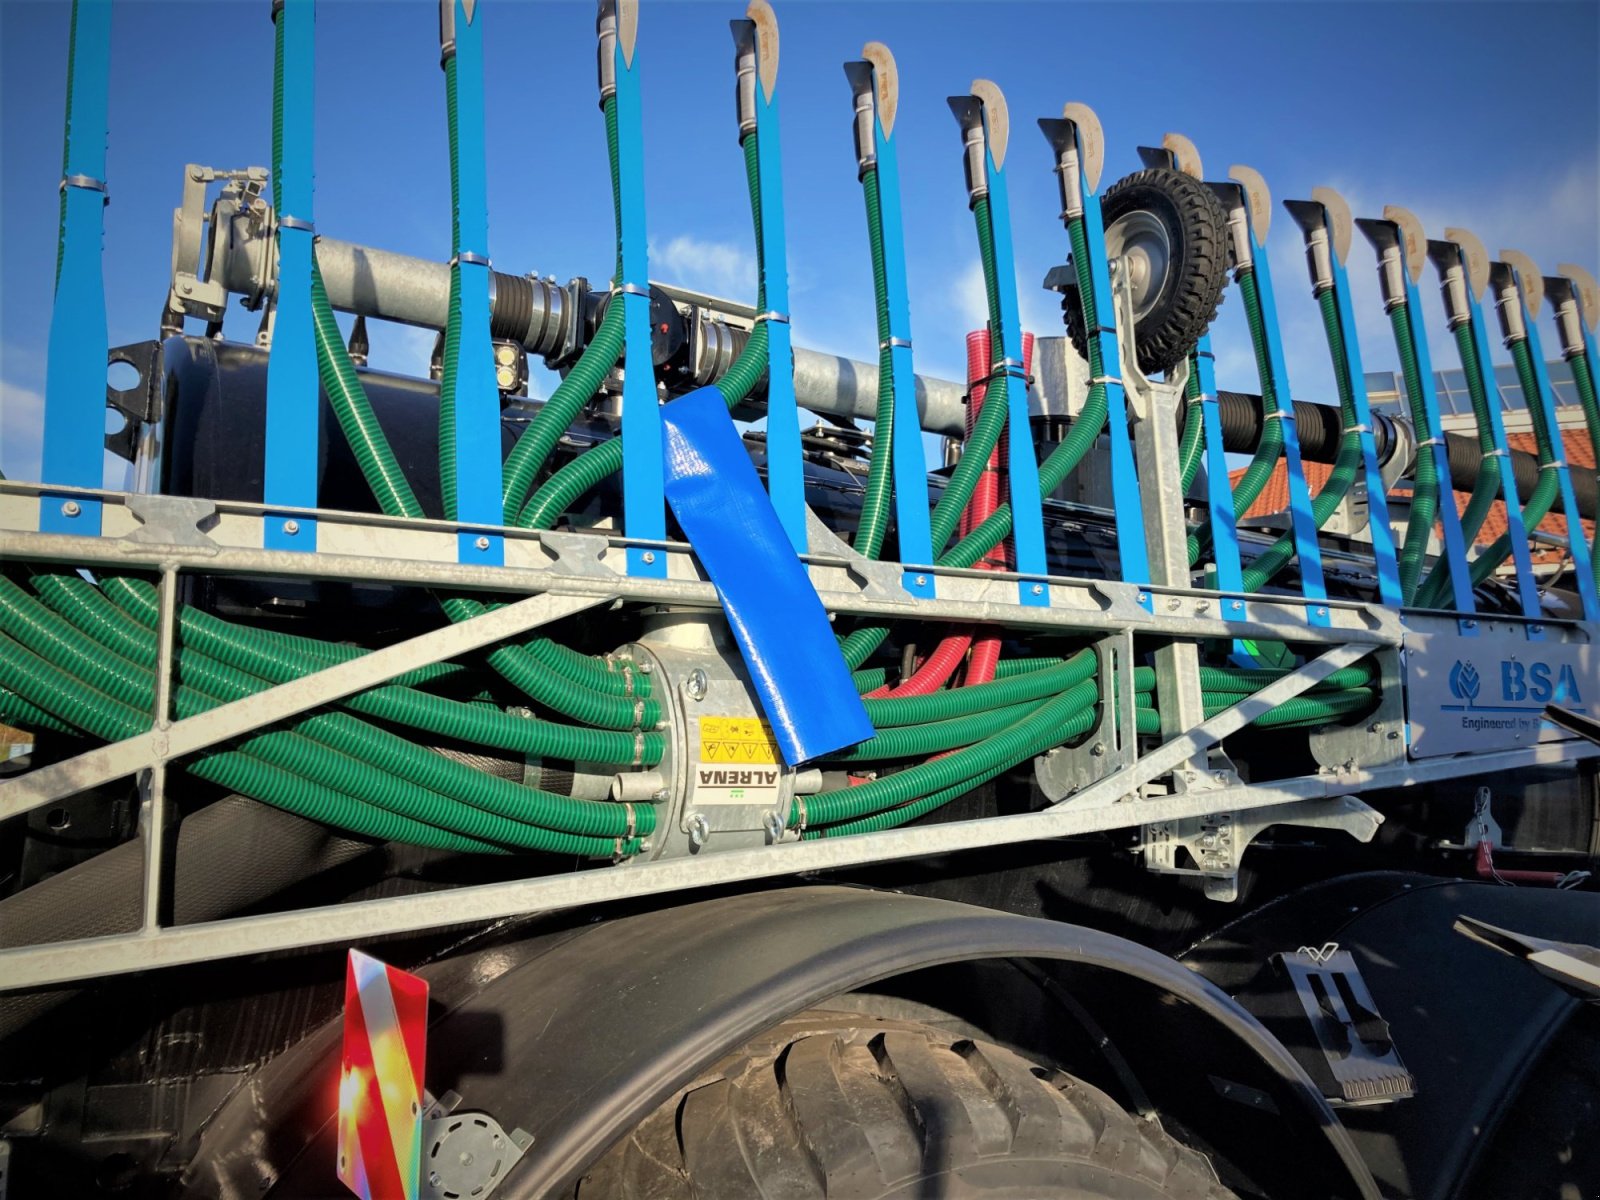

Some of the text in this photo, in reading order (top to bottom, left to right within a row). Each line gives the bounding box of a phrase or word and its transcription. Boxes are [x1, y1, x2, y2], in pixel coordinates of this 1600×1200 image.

[1501, 660, 1582, 704] BSA
[1462, 716, 1516, 732] Engineered
[1518, 718, 1530, 731] by
[699, 770, 778, 785] ALRENA
